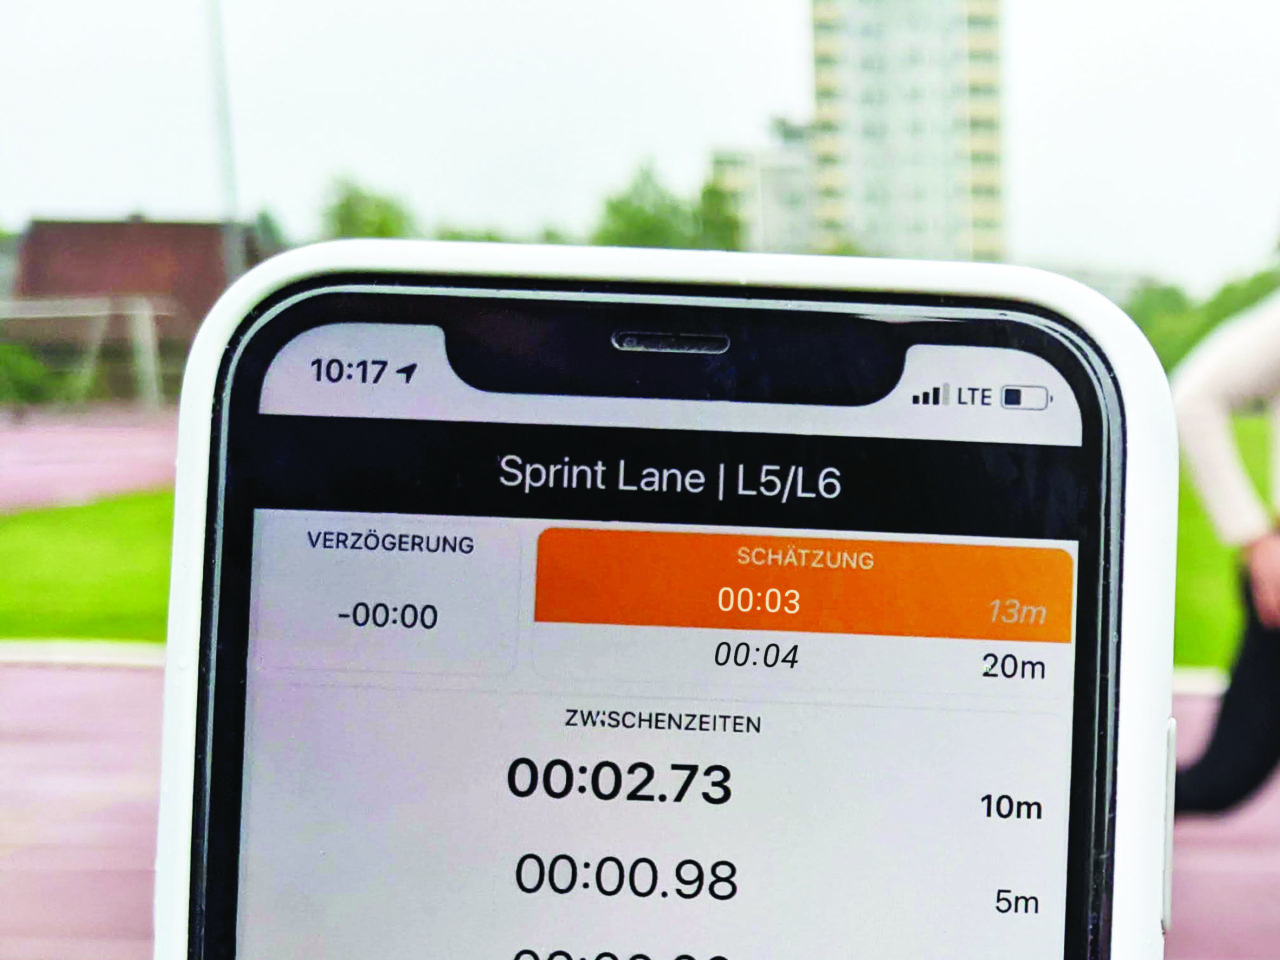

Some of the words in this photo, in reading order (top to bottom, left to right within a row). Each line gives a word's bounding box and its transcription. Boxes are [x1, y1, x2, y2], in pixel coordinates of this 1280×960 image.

[310, 358, 389, 384] 10:17
[957, 387, 992, 406] LTE
[499, 454, 607, 494] Sprint
[618, 459, 706, 493] Lane
[737, 464, 842, 504] L5/L6
[307, 530, 474, 555] VERZÖGERUNG
[737, 546, 874, 571] SCHÄTZUNG
[718, 586, 800, 615] 00:03
[988, 597, 1049, 627] 13m
[338, 601, 438, 630] -00:00
[714, 641, 799, 669] 00:04
[981, 652, 1048, 681] 20m
[564, 708, 761, 734] ZWISCHENZEITEN
[507, 757, 732, 805] 00:02.73
[980, 793, 1042, 820] 10m
[515, 853, 738, 901] 00:00.98
[995, 888, 1039, 914] 5m
